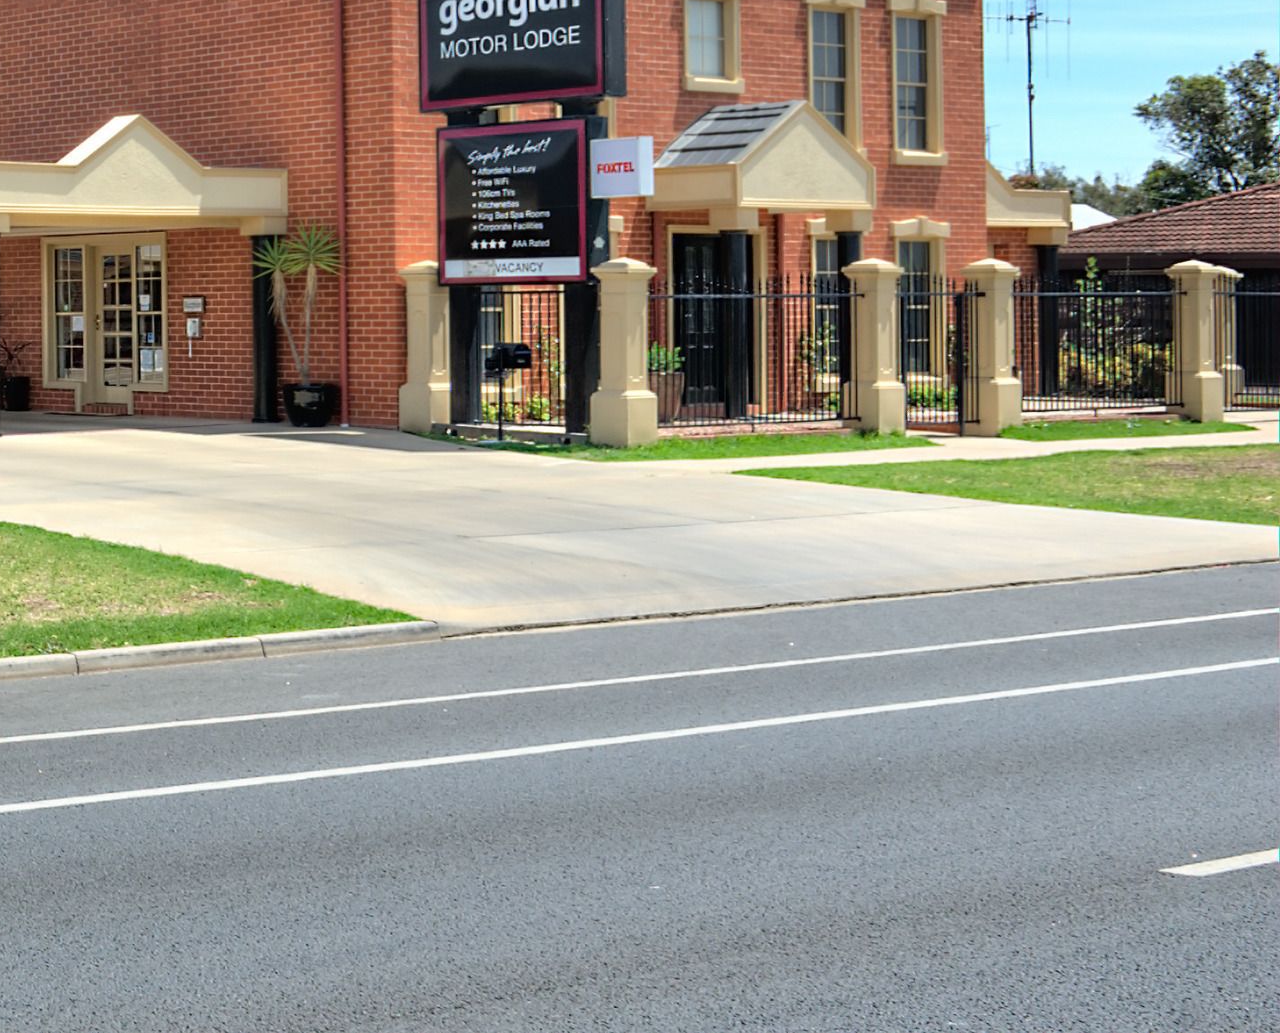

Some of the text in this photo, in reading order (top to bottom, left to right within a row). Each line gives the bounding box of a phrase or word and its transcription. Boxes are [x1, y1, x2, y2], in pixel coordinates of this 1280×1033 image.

[440, 25, 581, 59] MOTOR LODGE
[467, 147, 501, 165] Simply
[597, 162, 634, 174] FOXTEL
[477, 178, 493, 187] Free
[478, 209, 551, 221] King Bed Spa Rooms
[478, 222, 544, 232] Corporate Facilities
[512, 239, 551, 248] AAA Rated
[496, 262, 544, 273] VACANCY
